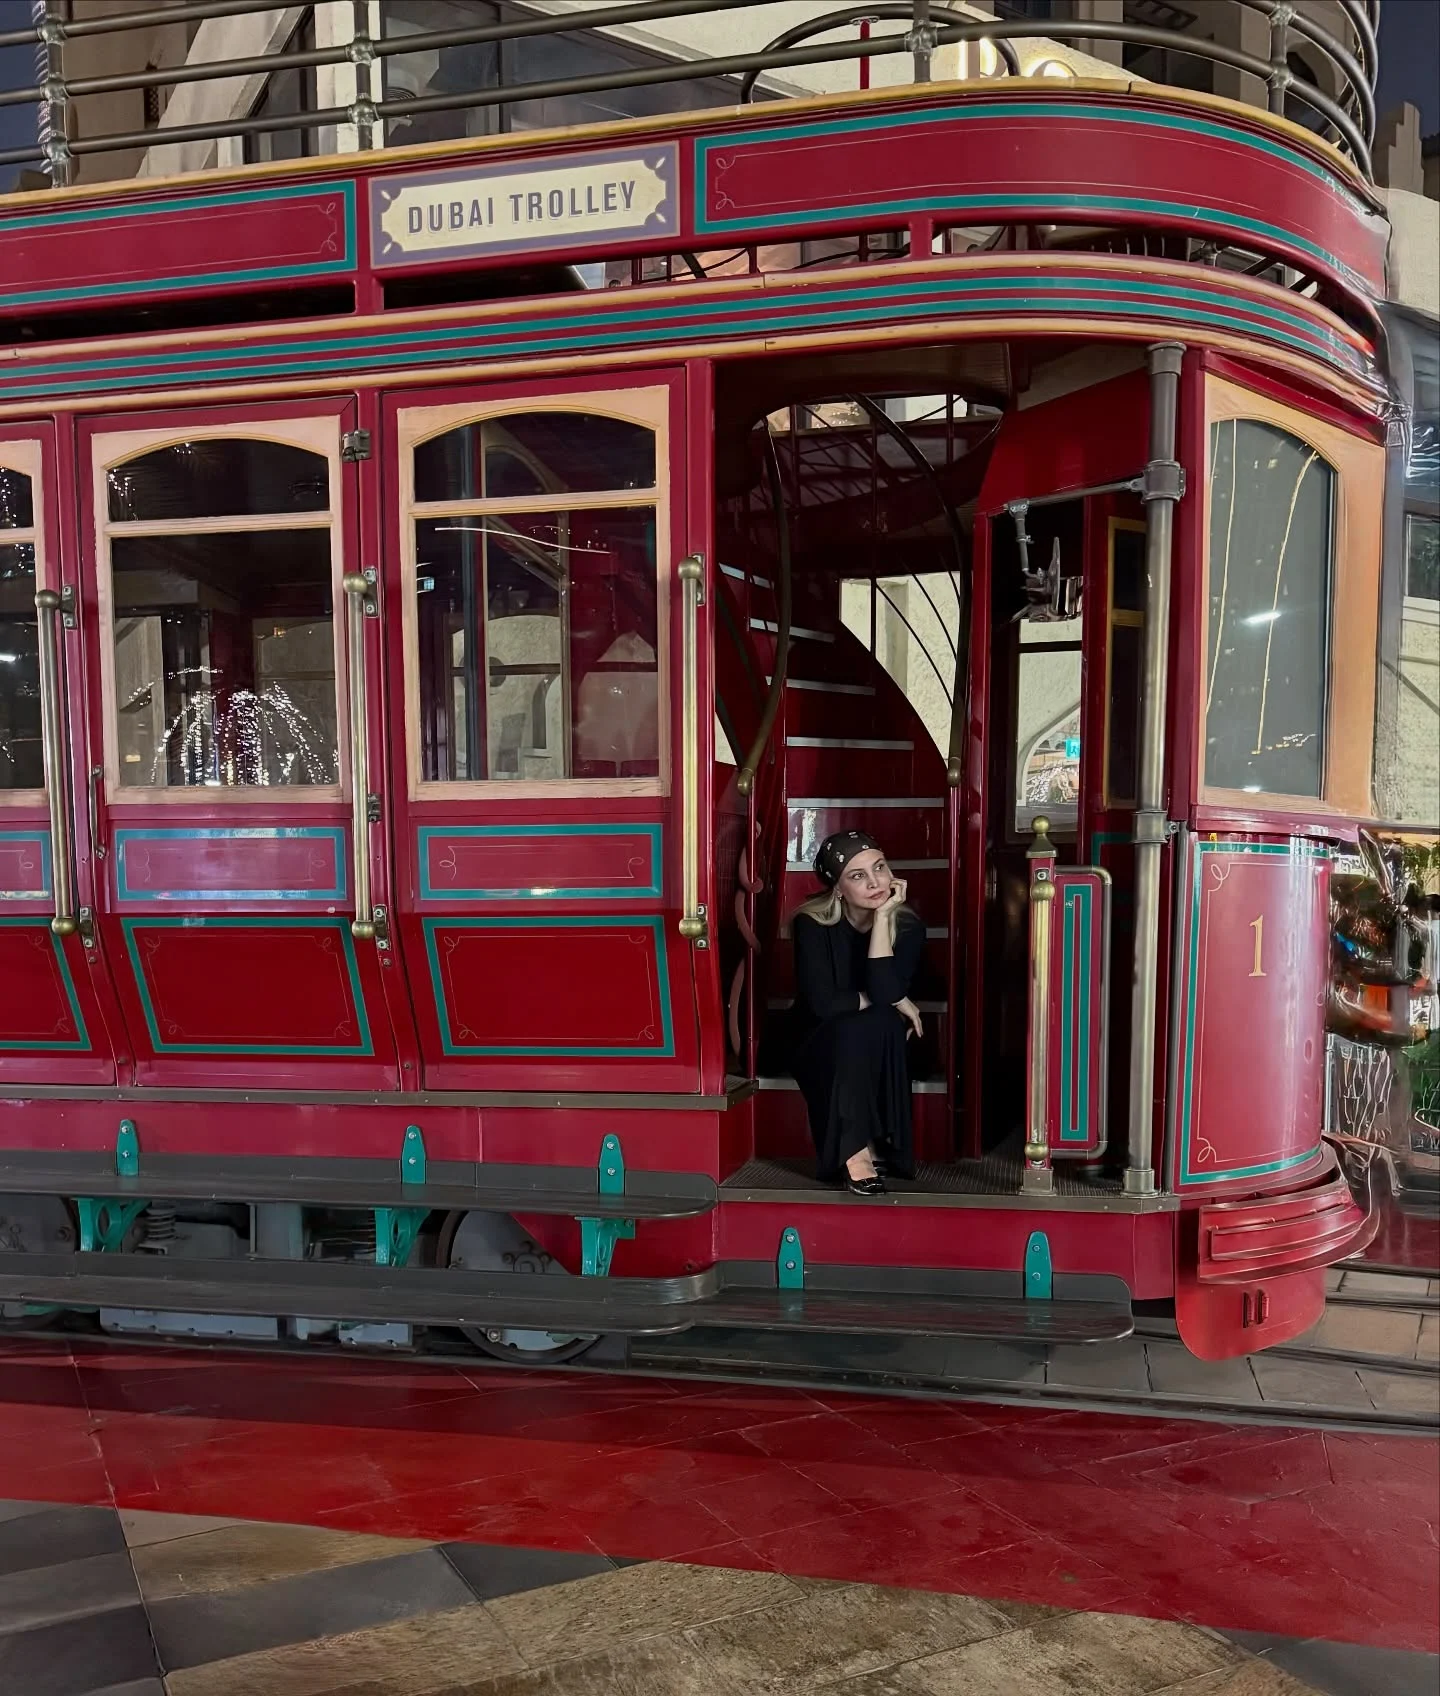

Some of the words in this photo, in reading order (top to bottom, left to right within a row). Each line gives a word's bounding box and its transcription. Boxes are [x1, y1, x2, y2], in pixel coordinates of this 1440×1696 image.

[407, 196, 494, 234] DUBAI
[509, 180, 637, 223] TROLLEY
[1248, 915, 1267, 977] 1
